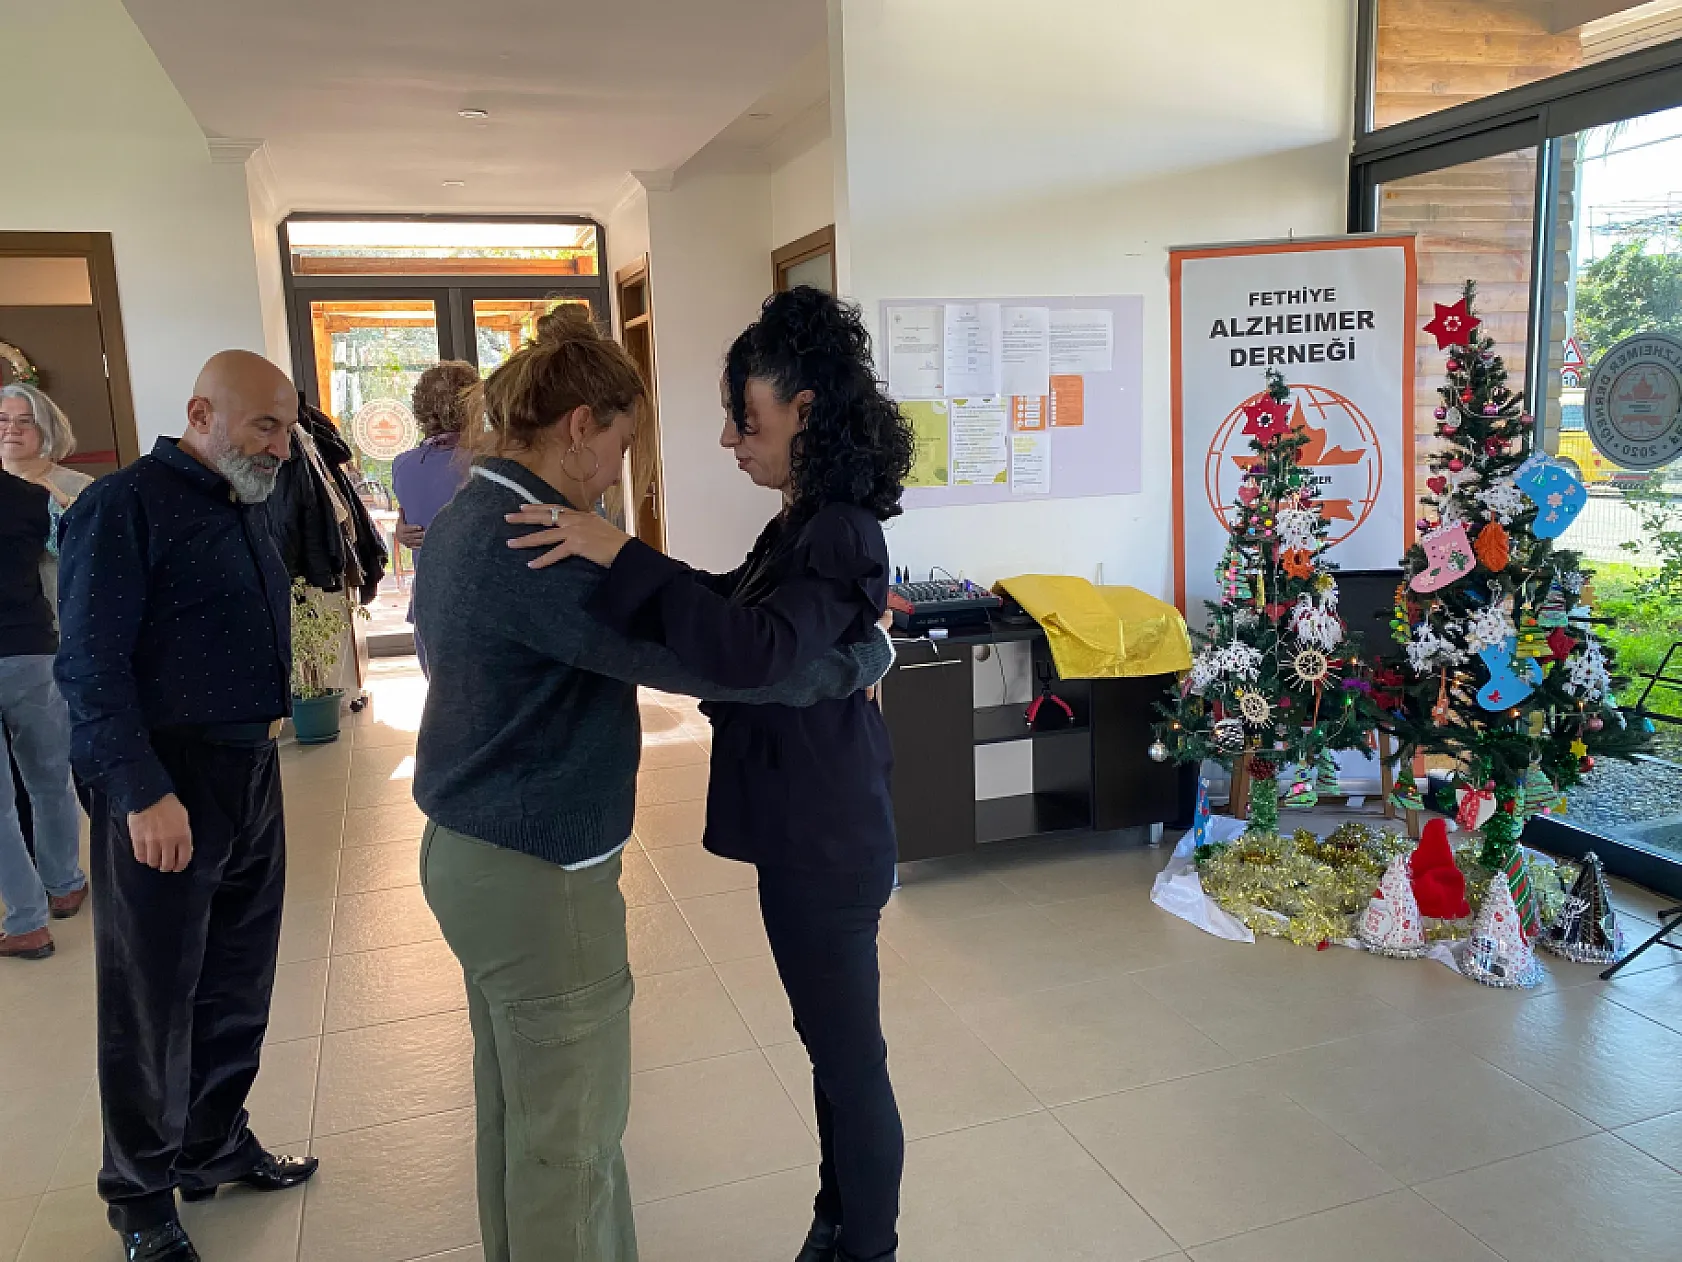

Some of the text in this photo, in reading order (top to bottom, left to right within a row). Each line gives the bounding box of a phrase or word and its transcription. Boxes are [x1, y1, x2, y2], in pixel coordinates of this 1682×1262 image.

[1249, 286, 1336, 307] FETHİYE
[1209, 310, 1376, 339] ALZHEIMER
[1230, 336, 1356, 368] DERNEĞİ
